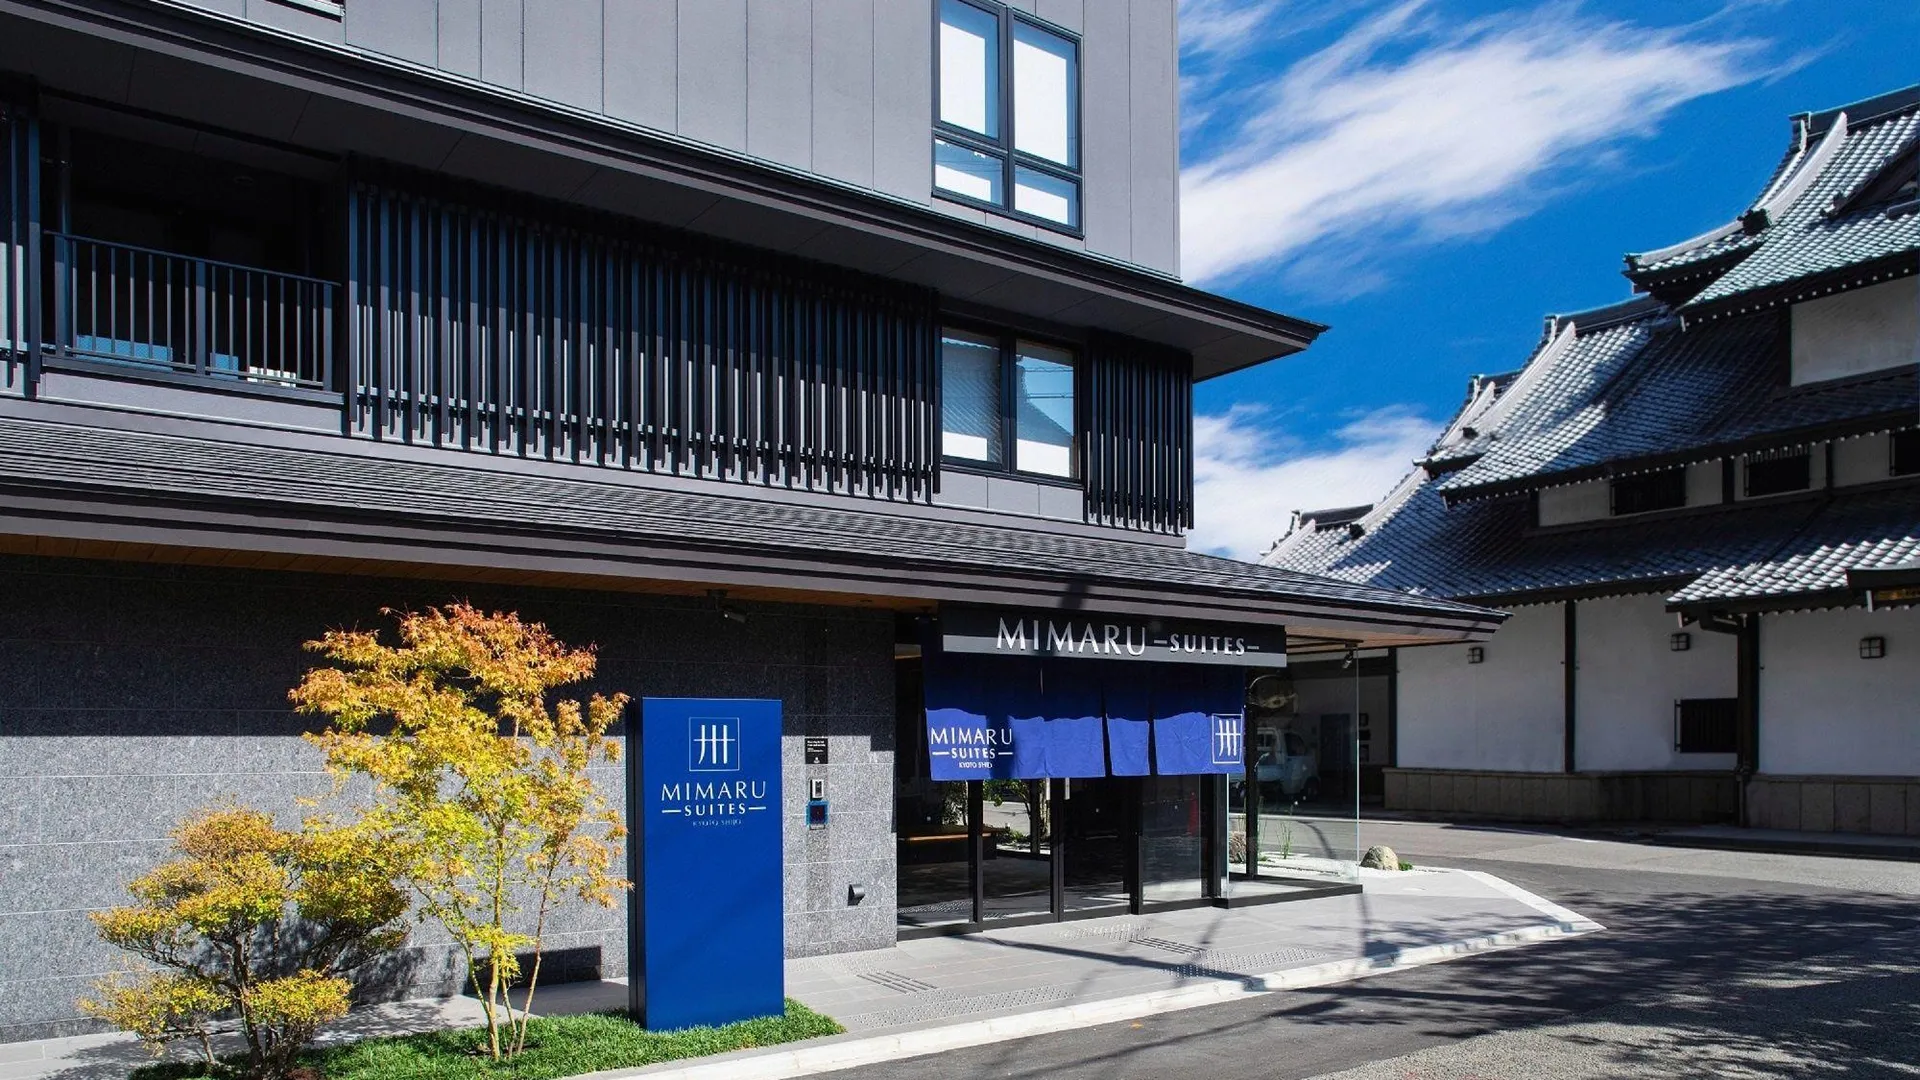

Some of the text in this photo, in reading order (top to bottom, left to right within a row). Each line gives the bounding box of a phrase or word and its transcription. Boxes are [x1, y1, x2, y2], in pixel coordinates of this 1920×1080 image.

[997, 617, 1245, 656] MIMARU SUITES
[930, 727, 1012, 745] MIMARU
[951, 748, 996, 759] SUITES
[661, 781, 766, 801] MIMARU
[684, 803, 746, 817] SUITES
